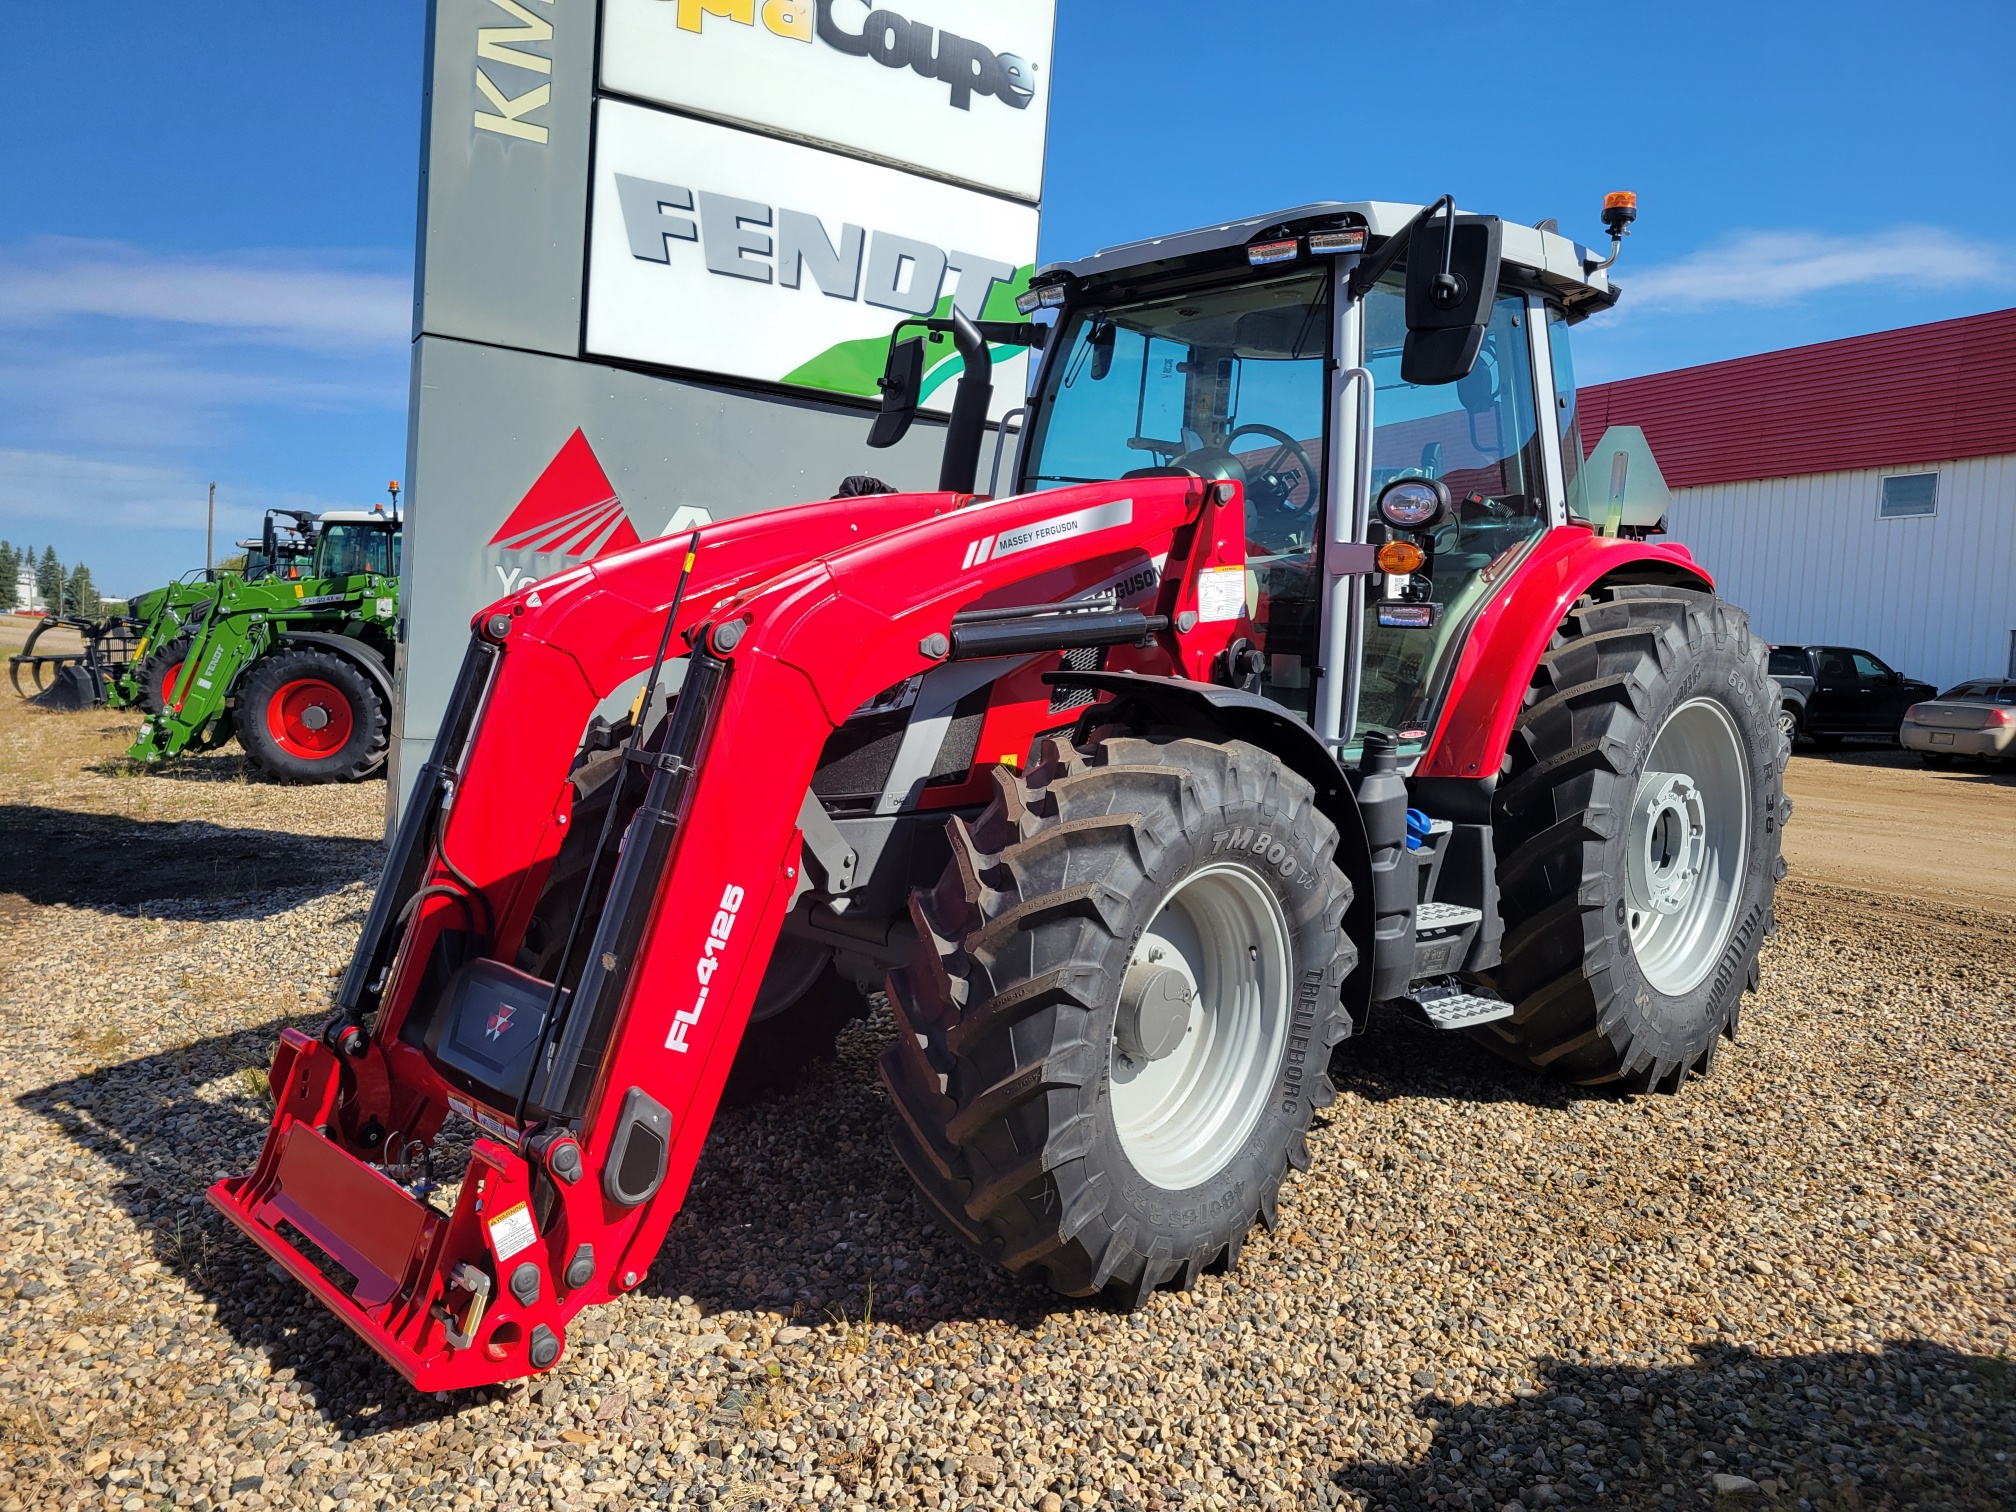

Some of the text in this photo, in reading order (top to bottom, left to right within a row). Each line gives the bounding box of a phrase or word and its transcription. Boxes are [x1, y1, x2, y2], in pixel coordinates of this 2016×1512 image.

[614, 172, 1018, 322] FENDT
[999, 520, 1078, 551] MASSEY FERGUSON
[204, 643, 224, 677] FENDT
[1210, 825, 1299, 878] TM800
[664, 883, 745, 1054] FL.4125
[1705, 903, 1764, 1023] TRELLEBORG
[1281, 966, 1325, 1117] TRELLEBORG
[497, 1202, 526, 1222] WARNING
